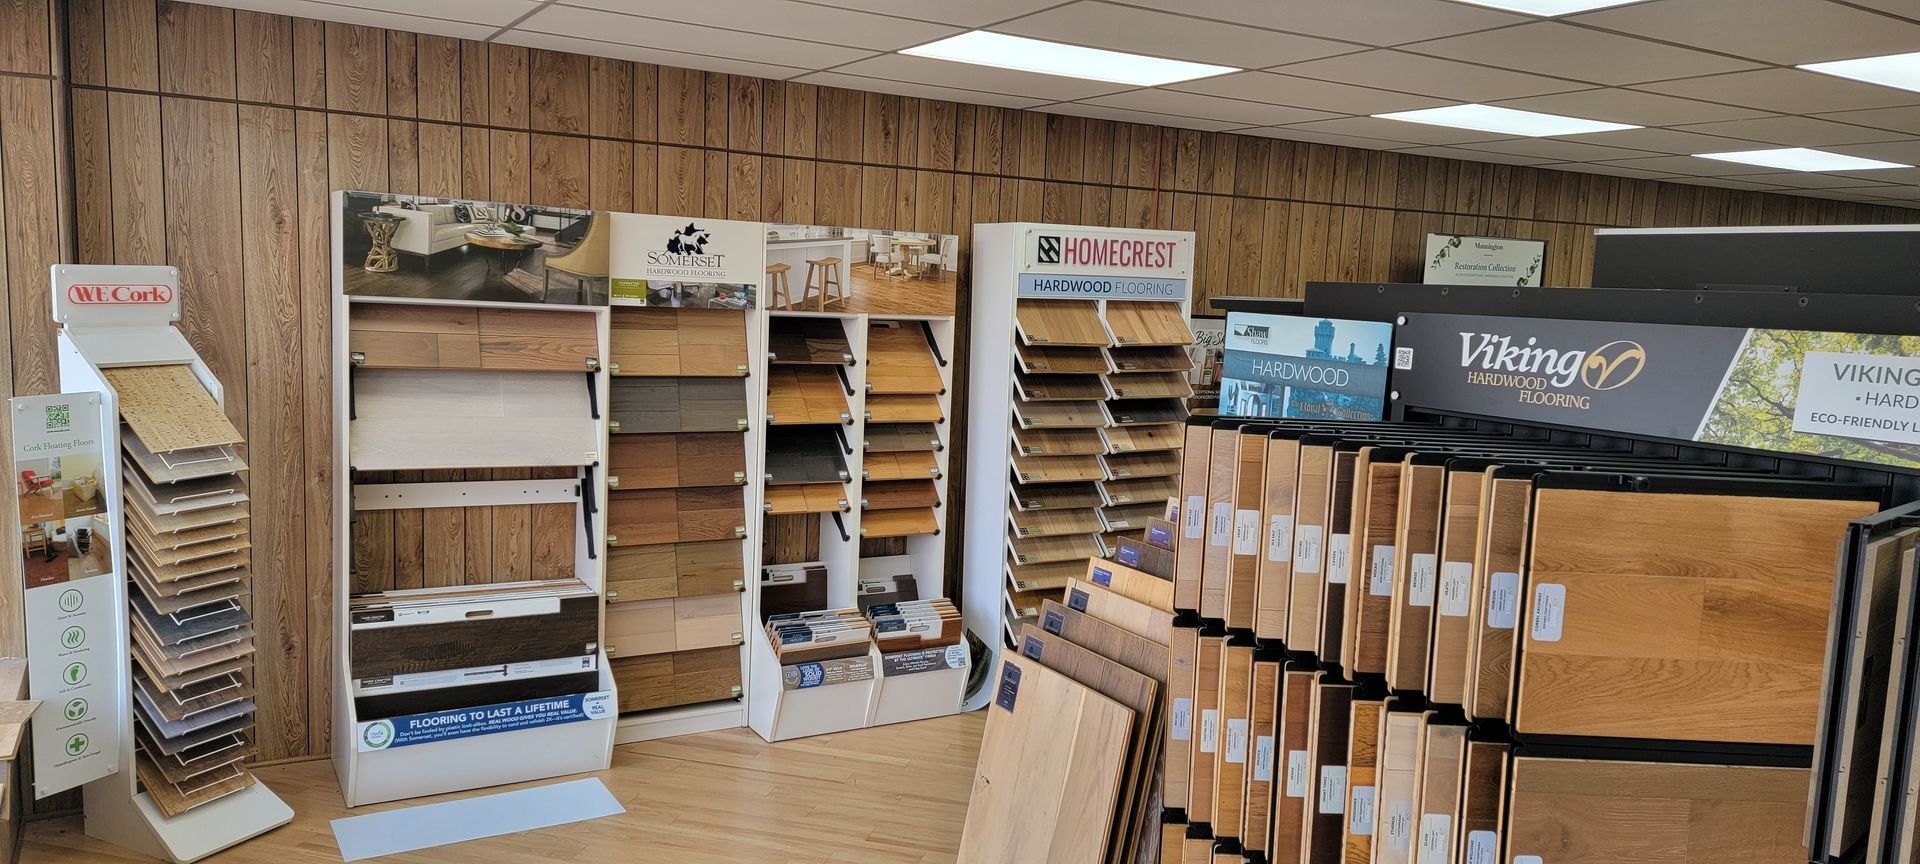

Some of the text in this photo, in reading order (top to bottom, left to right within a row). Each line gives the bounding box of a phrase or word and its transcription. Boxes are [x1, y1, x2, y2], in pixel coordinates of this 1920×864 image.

[647, 251, 726, 268] SOMERSET
[1064, 237, 1177, 268] HOMECREST
[646, 267, 726, 277] HARDWOOD FLOORING
[1454, 262, 1516, 272] Restoration Collection
[75, 286, 168, 302] WE Cork
[1034, 279, 1173, 295] HARDWOOD FLOORING
[1195, 331, 1212, 348] Big
[1247, 326, 1269, 338] Shaw
[1459, 332, 1587, 388] Viking
[1252, 359, 1349, 388] HARDWOOD
[1467, 371, 1547, 390] HARDWOOD
[1833, 363, 1920, 387] VIKING
[1519, 390, 1591, 410] FLOORING
[1810, 412, 1910, 432] ECO-FRIENDLY
[23, 439, 94, 452] Cork Floating Floors
[409, 700, 570, 729] FLOORING TO LAST A LIFETIME
